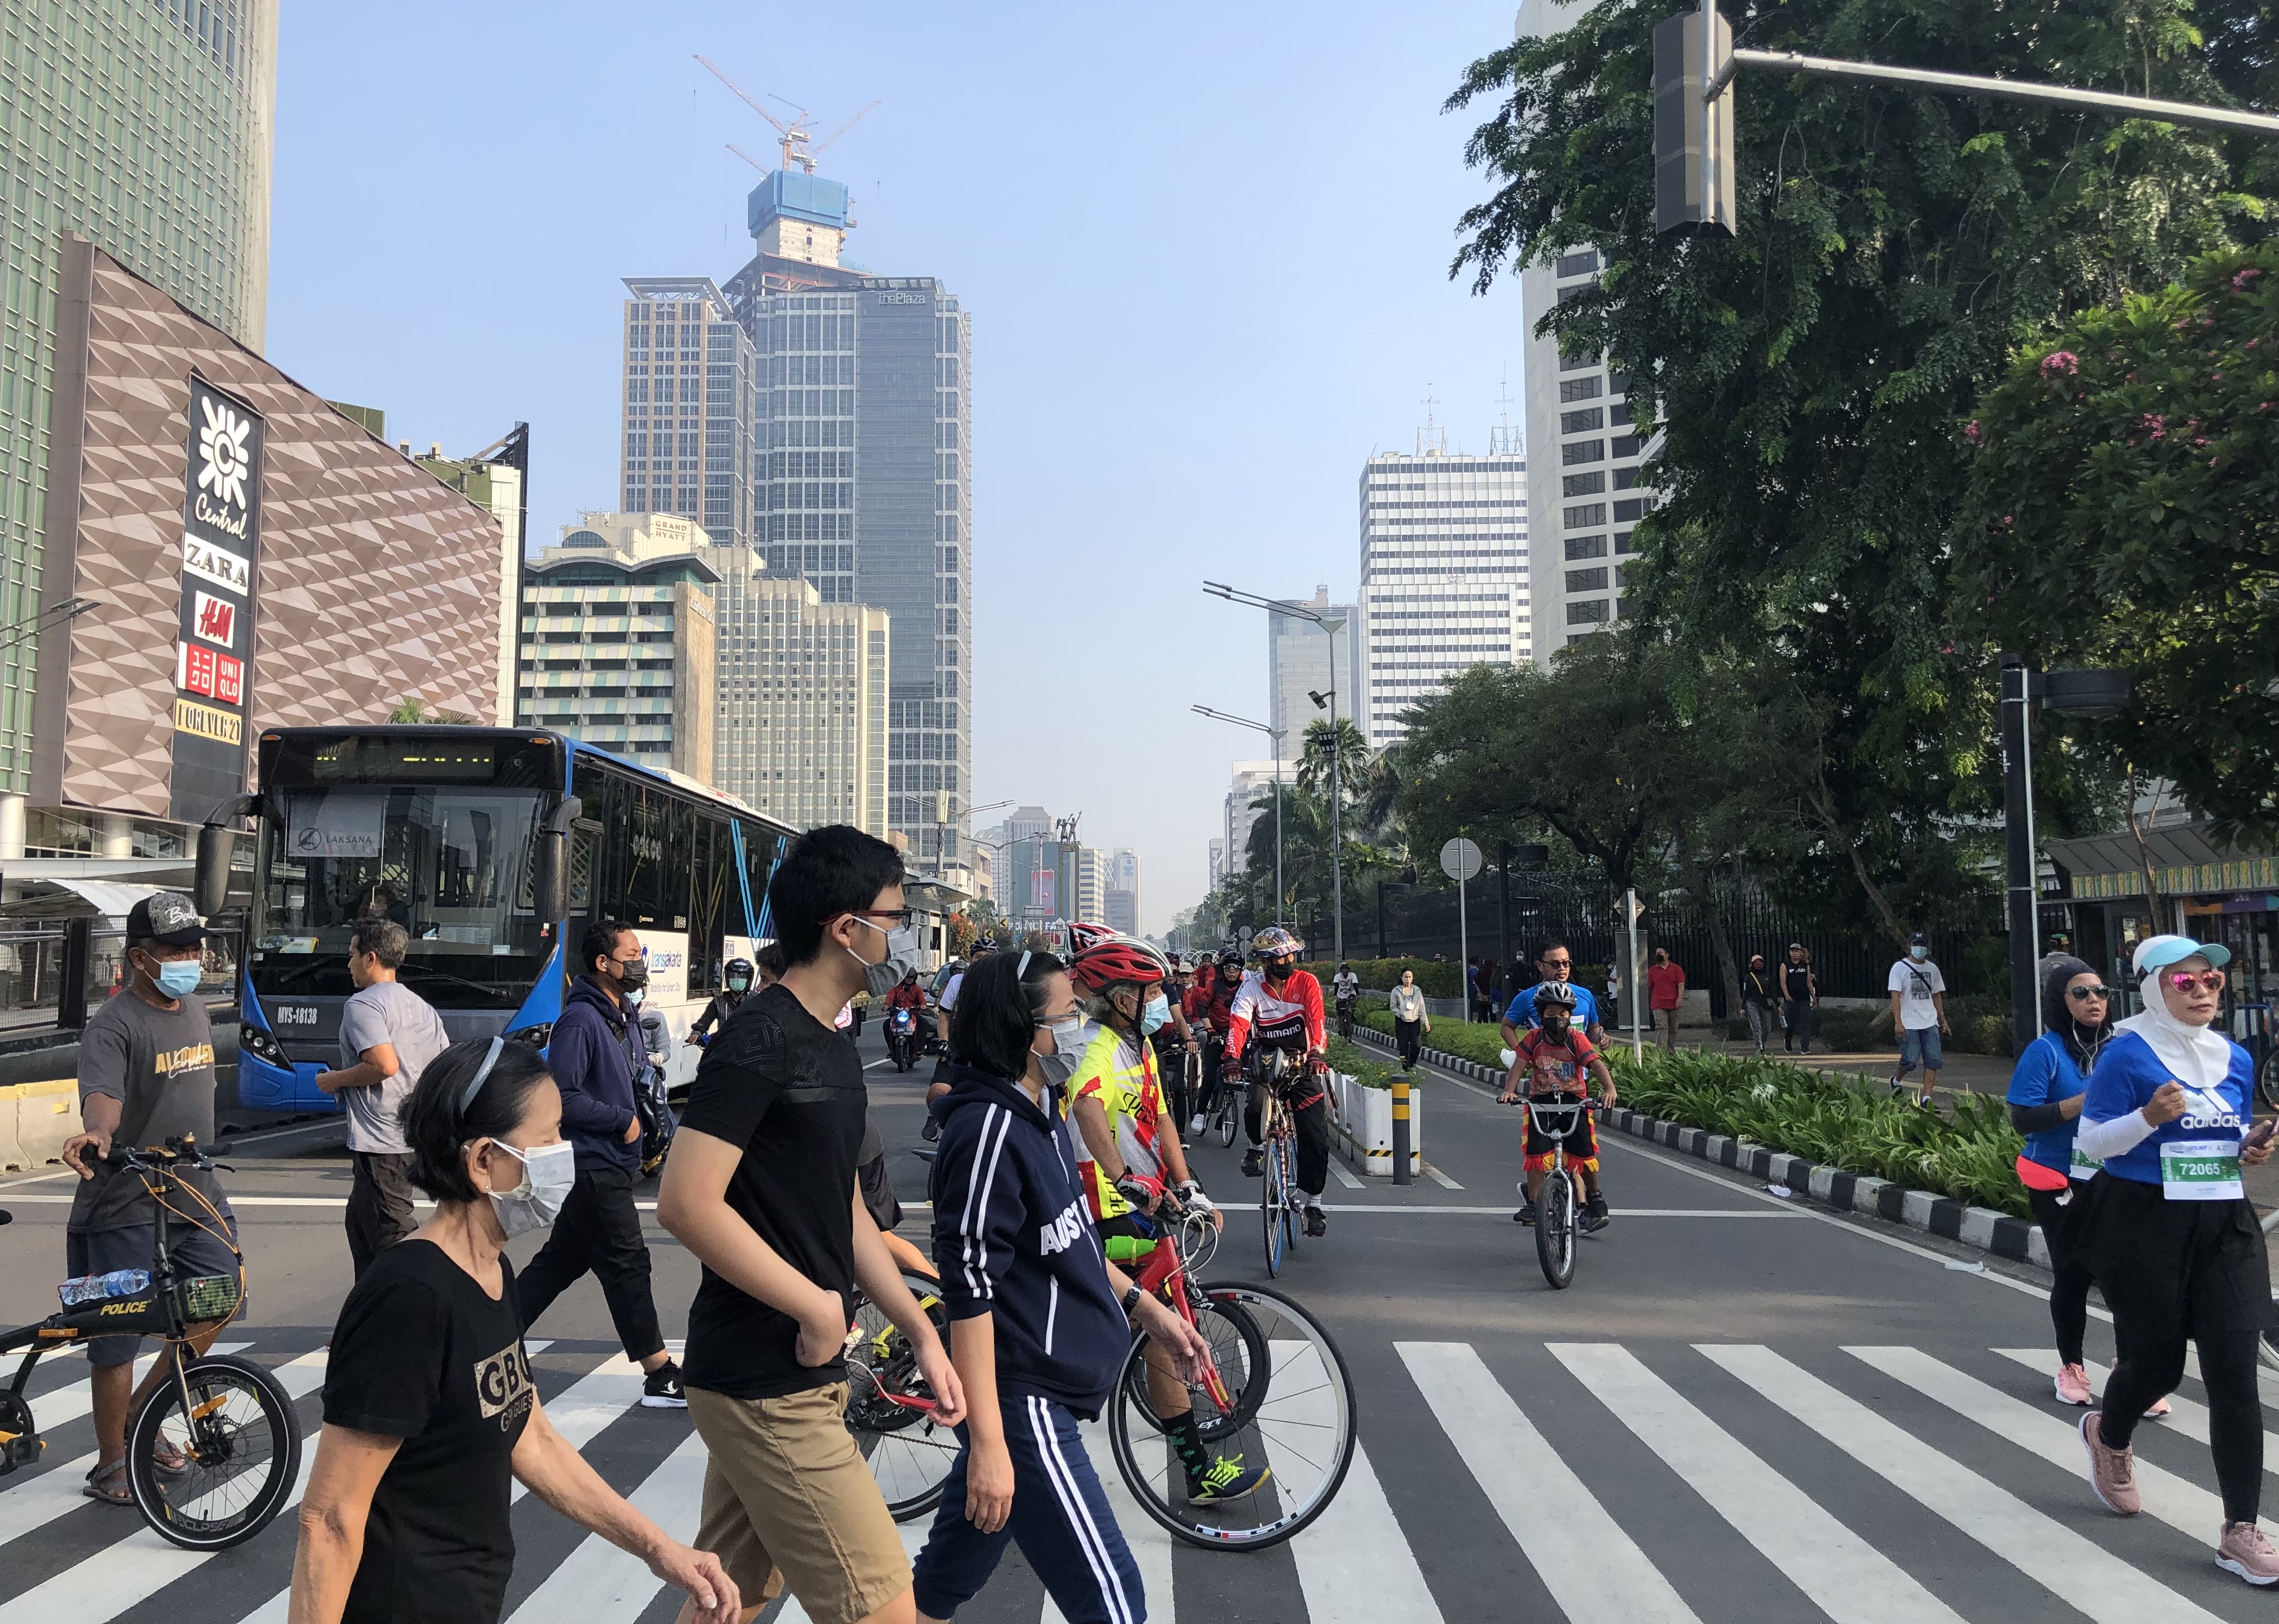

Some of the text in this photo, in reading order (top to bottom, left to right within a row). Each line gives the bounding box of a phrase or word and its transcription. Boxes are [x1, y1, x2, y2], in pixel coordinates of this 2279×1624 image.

[195, 493, 247, 540] Central
[656, 520, 687, 531] GRAND
[656, 531, 686, 541] HYATT
[186, 543, 248, 588] ZARA
[200, 598, 233, 644] H&M
[221, 660, 237, 680] UNI
[220, 678, 238, 697] QLO
[178, 704, 242, 741] FOREVER 21
[651, 950, 682, 969] transjakarta
[278, 1006, 318, 1024] MYS-18138
[1258, 1024, 1302, 1039] SHIMANO
[2181, 1111, 2241, 1130] adidas
[2179, 1162, 2220, 1175] 72065
[100, 1301, 148, 1315] POLICE
